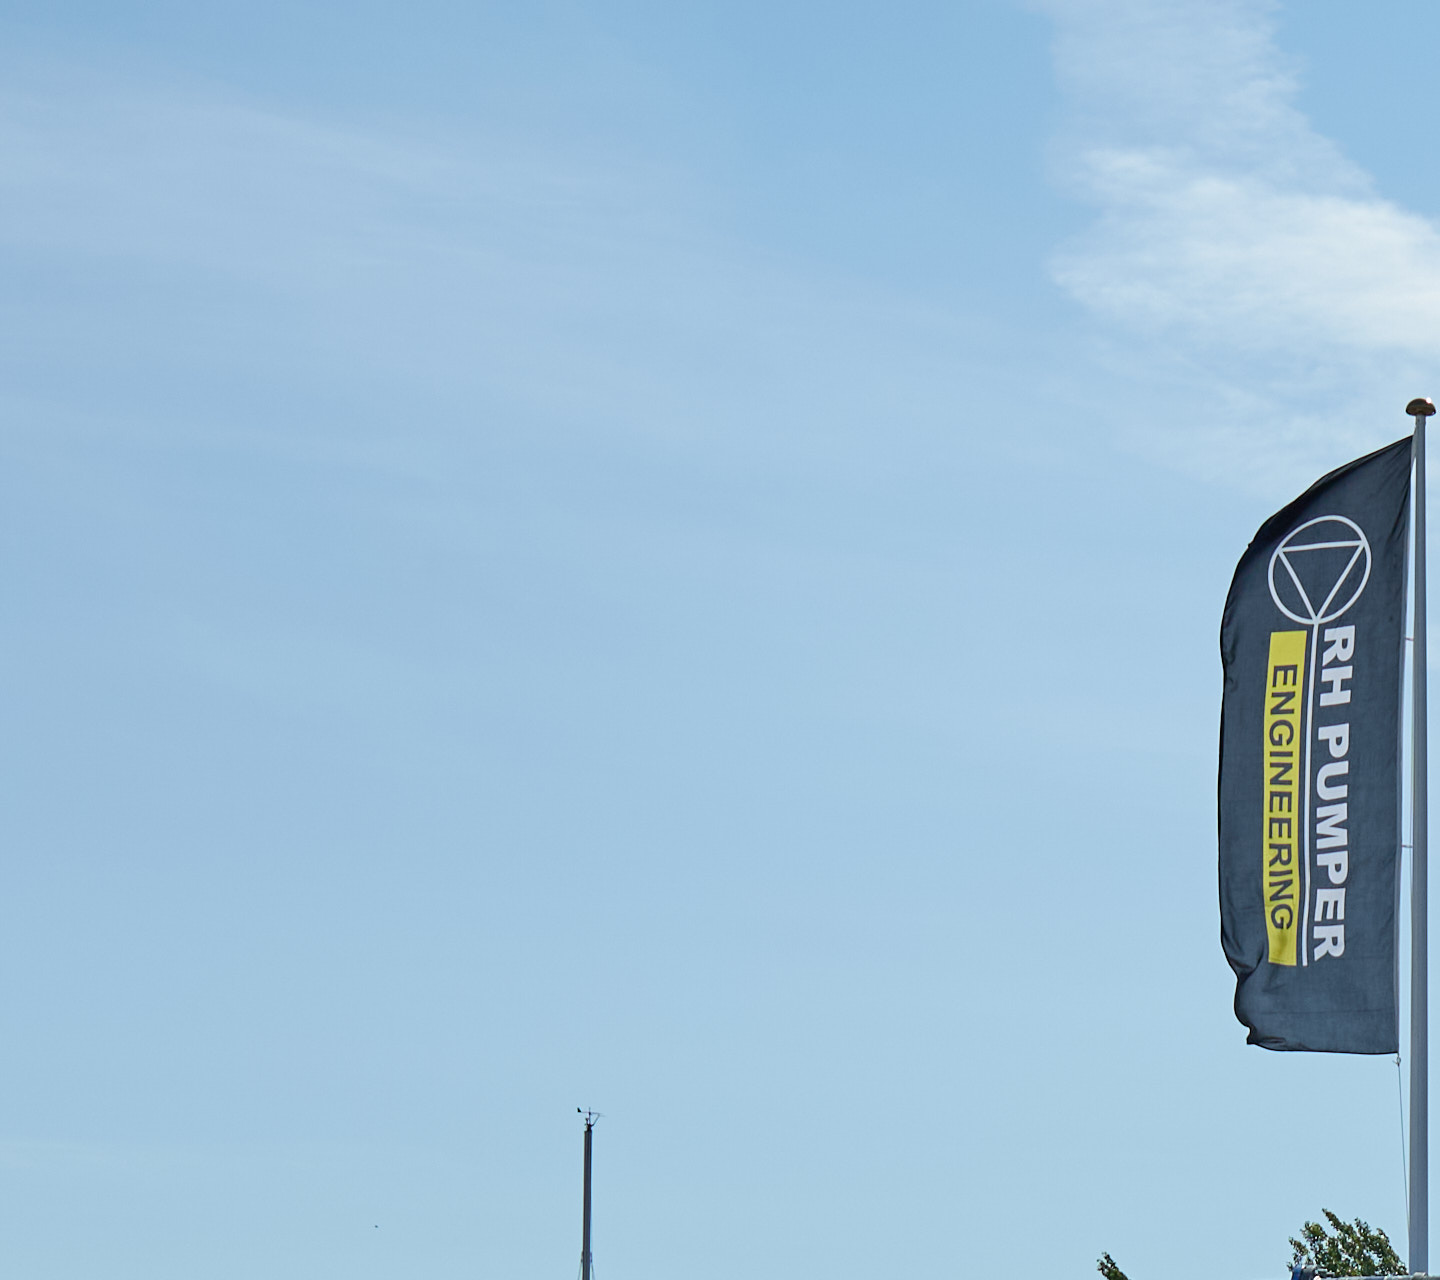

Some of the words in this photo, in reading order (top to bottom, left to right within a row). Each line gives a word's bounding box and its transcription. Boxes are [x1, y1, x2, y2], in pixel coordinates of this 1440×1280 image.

[1317, 625, 1356, 705] RH
[1268, 663, 1299, 931] ENGINEERING
[1312, 722, 1351, 962] PUMPER
